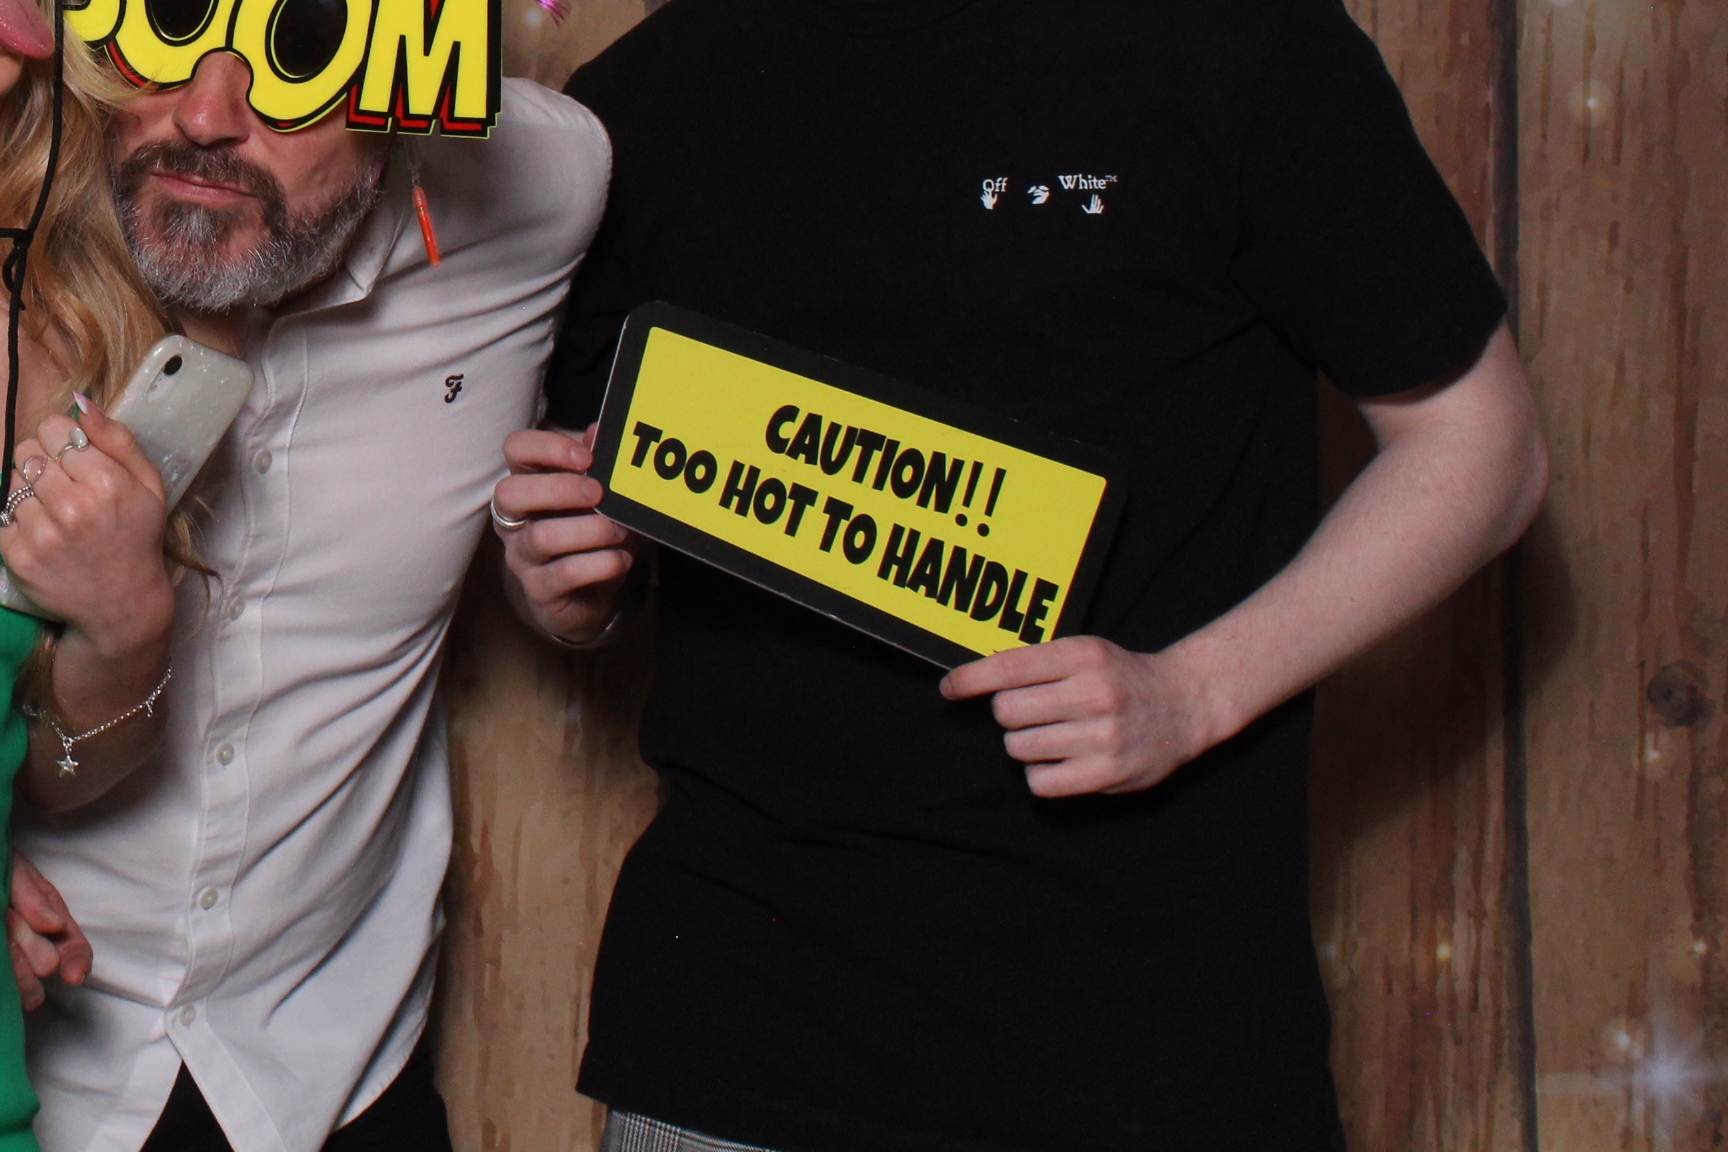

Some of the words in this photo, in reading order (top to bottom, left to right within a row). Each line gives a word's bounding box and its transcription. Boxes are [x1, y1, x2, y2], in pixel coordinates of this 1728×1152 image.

[982, 176, 1008, 193] Off
[630, 421, 718, 494] TOO
[718, 460, 818, 538] HOT
[819, 496, 878, 565] TO
[877, 523, 1060, 646] HANDLE
[765, 404, 1007, 538] CAUTION!!
